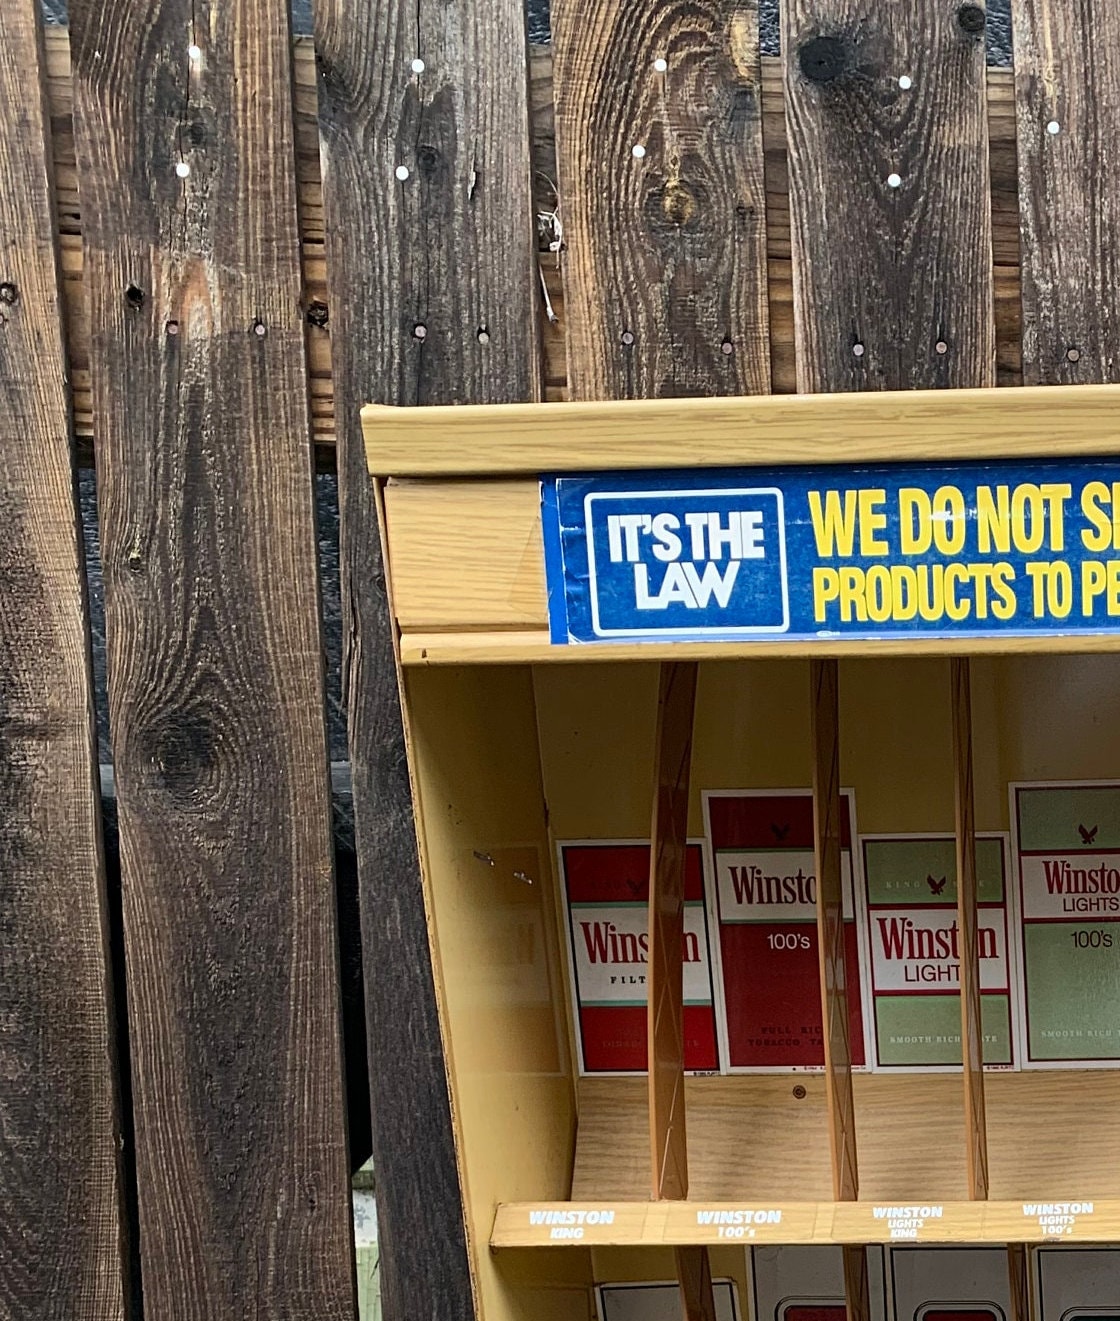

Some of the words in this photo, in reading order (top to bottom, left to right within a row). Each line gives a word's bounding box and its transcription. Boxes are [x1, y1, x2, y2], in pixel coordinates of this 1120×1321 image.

[808, 489, 888, 557] WE
[899, 485, 966, 555] DO
[977, 483, 1071, 553] NOT
[607, 513, 682, 562] IT'S
[685, 511, 764, 560] THE
[634, 561, 740, 609] LAW
[812, 562, 1016, 622] PRODUCTS
[1026, 560, 1072, 618] TO
[1063, 897, 1119, 912] LIGHTS
[767, 933, 810, 950] 100's
[1071, 931, 1113, 948] 100's
[873, 1207, 943, 1218] WINSTON
[1023, 1203, 1093, 1215] WINSTON
[530, 1211, 615, 1225] WINSTON
[697, 1210, 781, 1224] WINSTON
[888, 1219, 923, 1228] LIGHTS
[1039, 1215, 1074, 1224] LIGHTS
[551, 1227, 584, 1239] KING
[718, 1227, 755, 1237] 100's
[891, 1228, 916, 1238] KING
